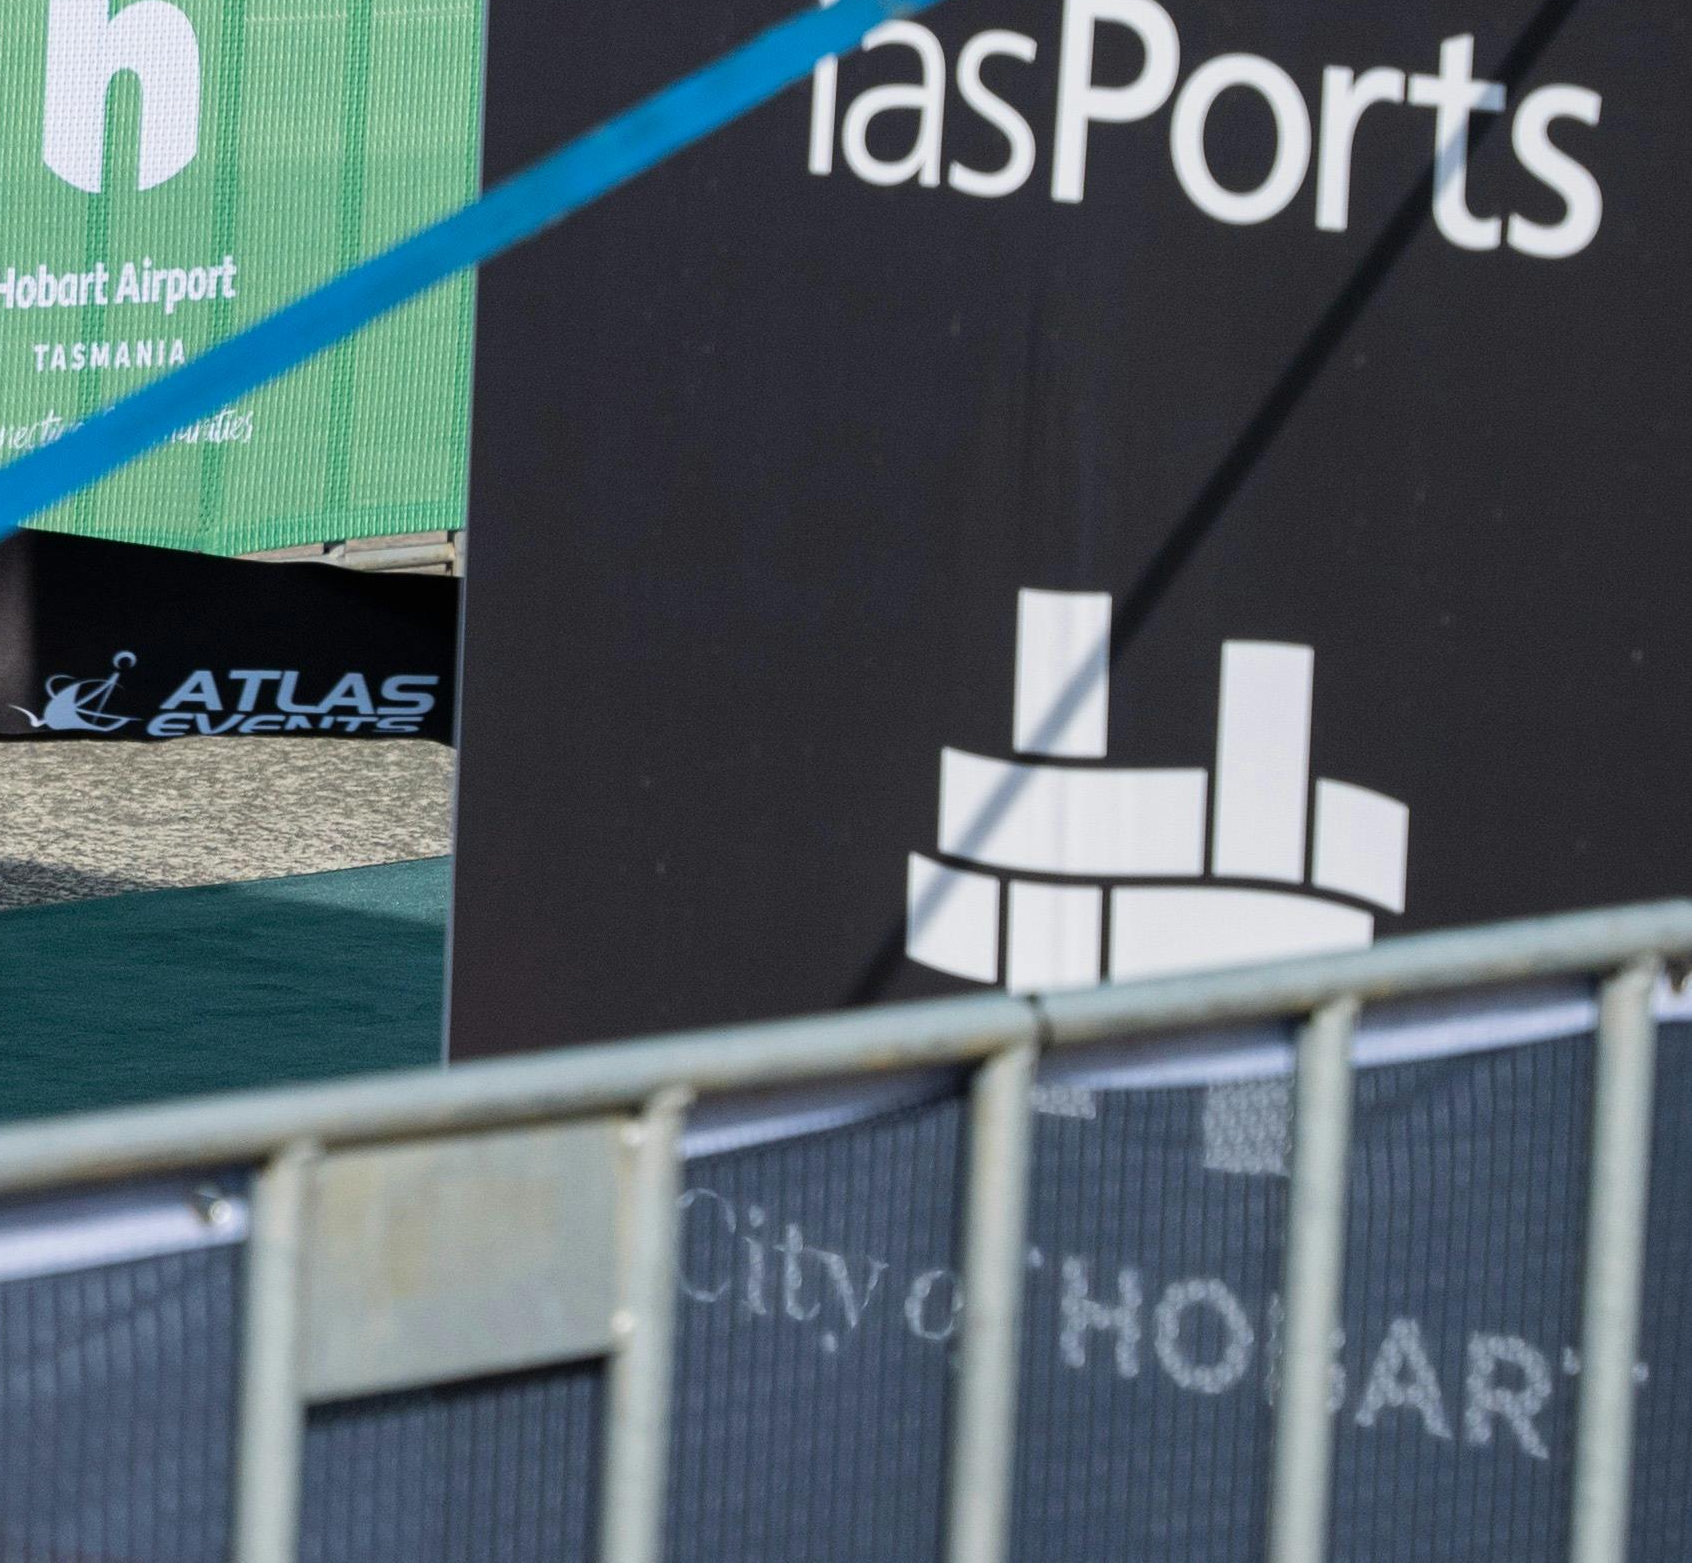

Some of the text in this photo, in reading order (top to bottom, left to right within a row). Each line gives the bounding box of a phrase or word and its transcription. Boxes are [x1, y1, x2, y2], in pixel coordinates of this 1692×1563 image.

[116, 255, 238, 314] Airport
[34, 339, 187, 372] TASMANIA
[160, 670, 440, 715] ATLAS
[675, 1187, 890, 1353] City
[1058, 1254, 1648, 1461] HOAR
